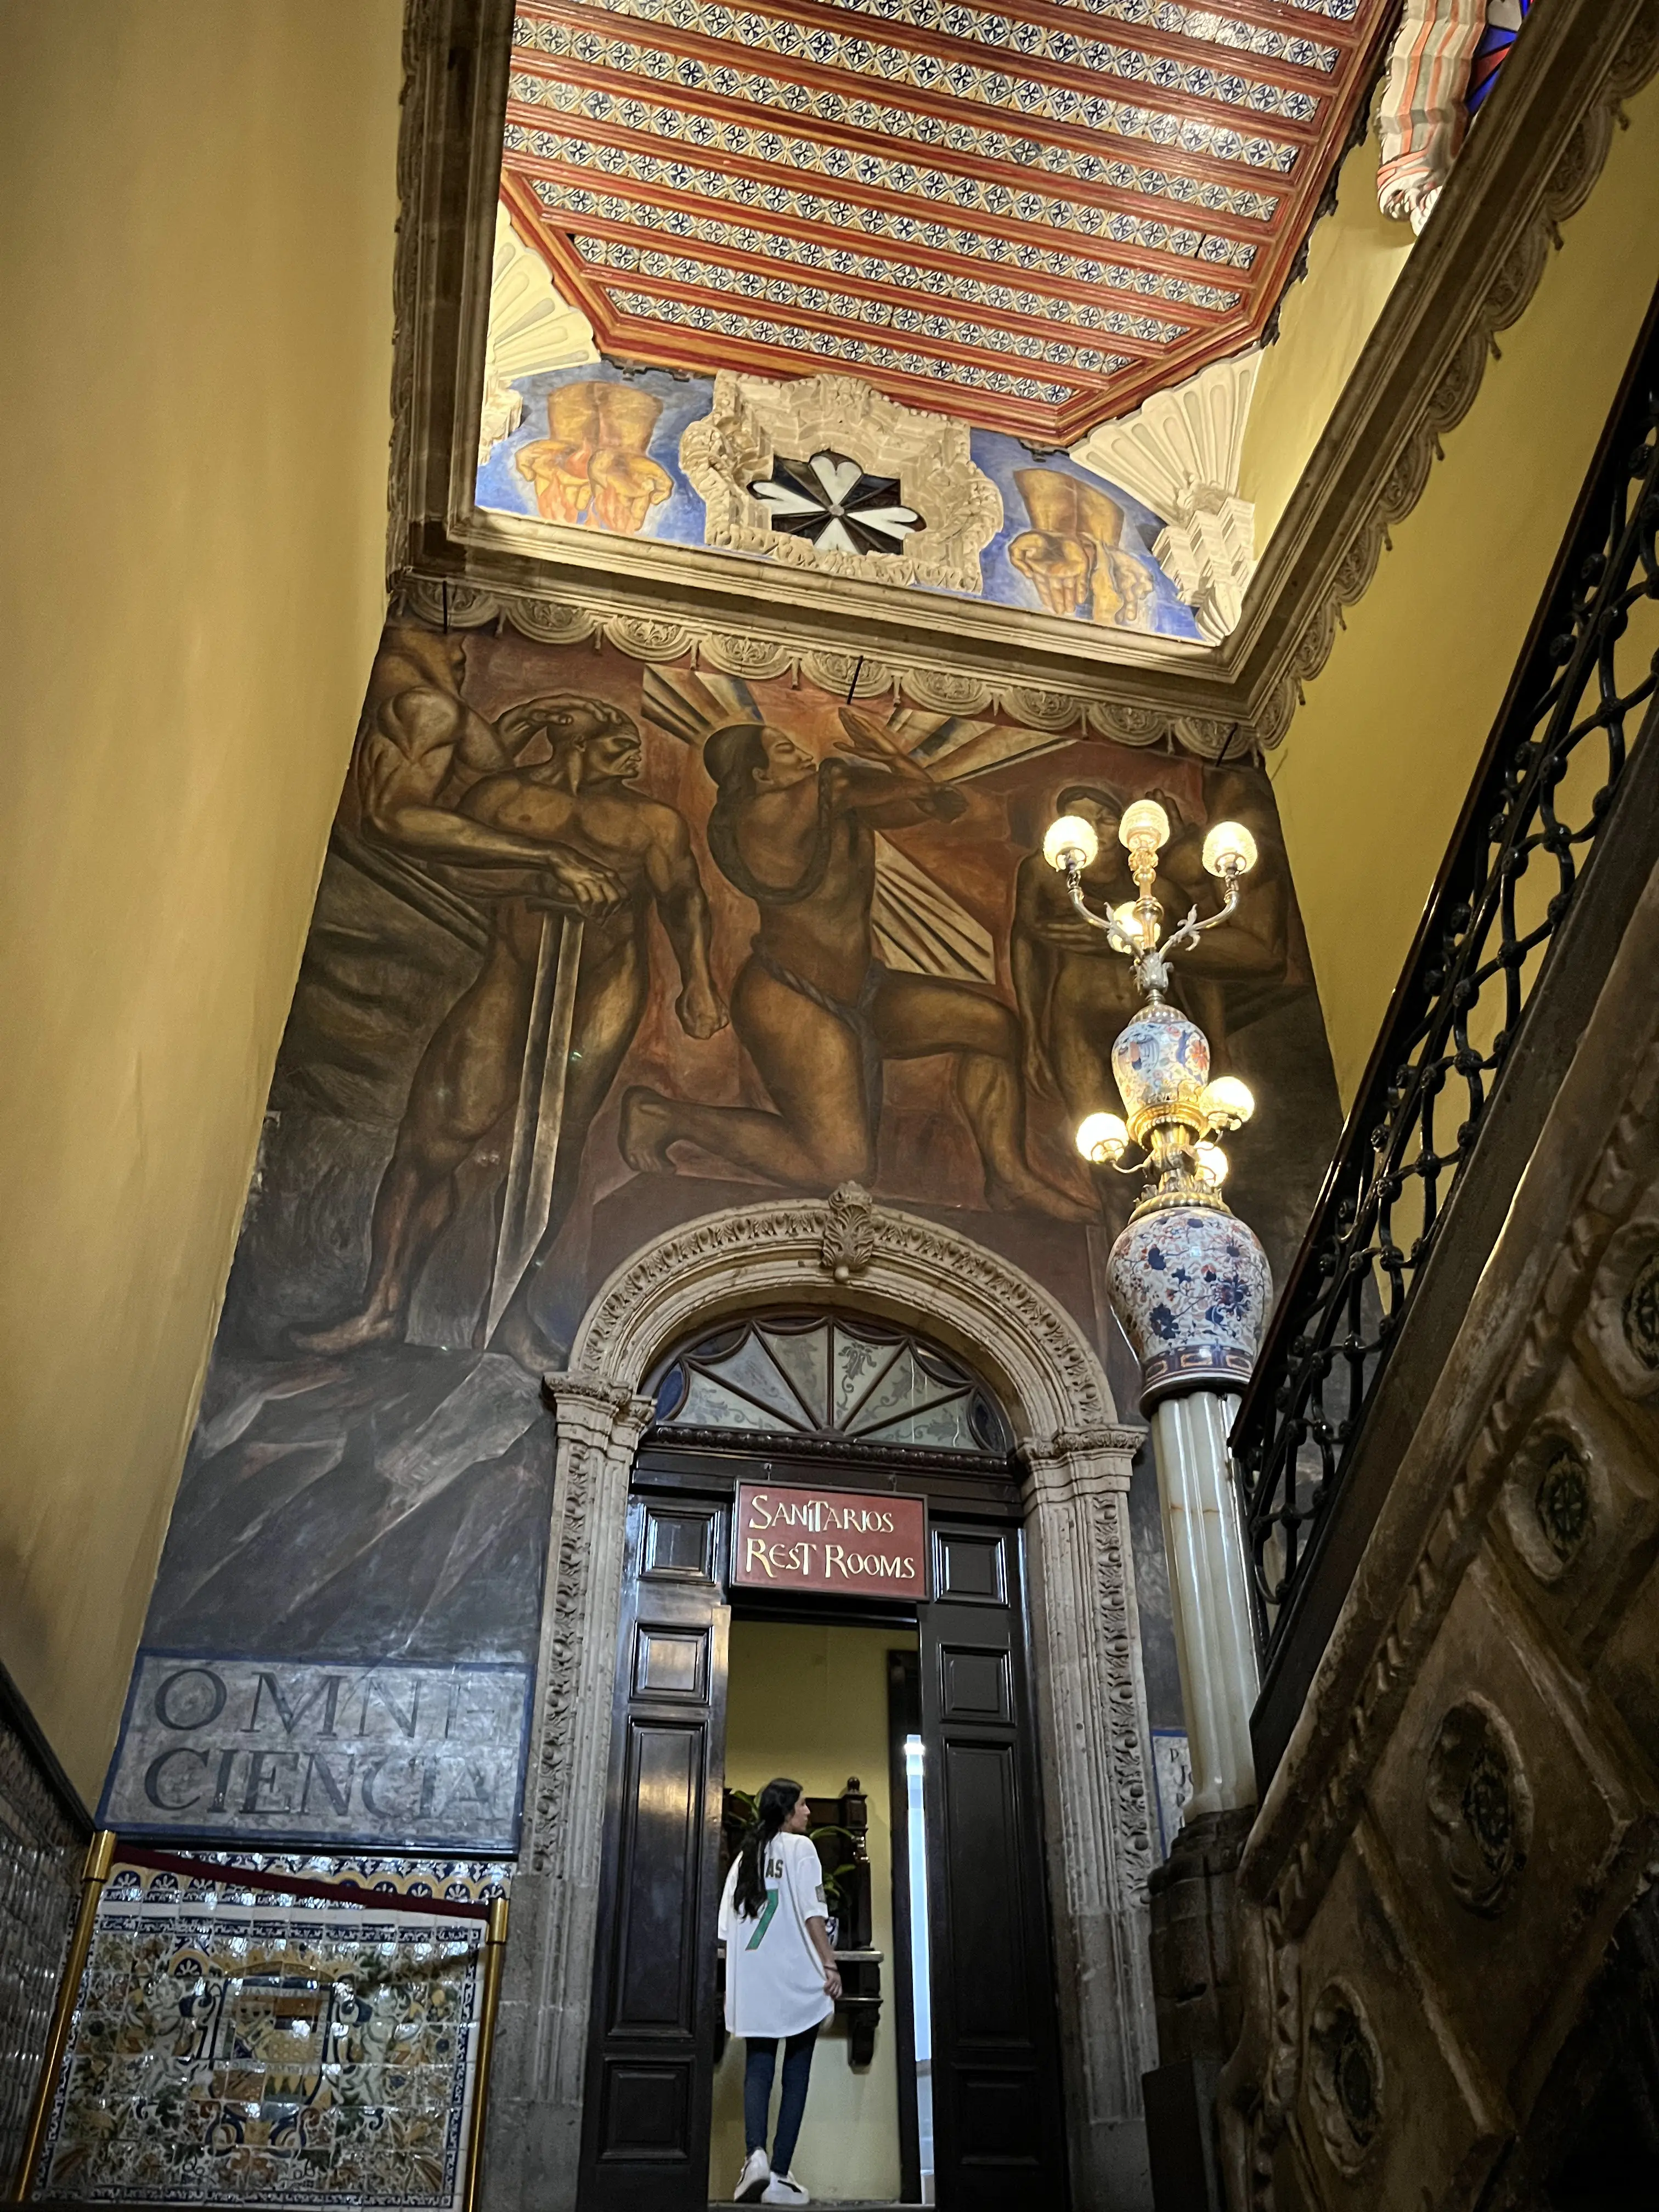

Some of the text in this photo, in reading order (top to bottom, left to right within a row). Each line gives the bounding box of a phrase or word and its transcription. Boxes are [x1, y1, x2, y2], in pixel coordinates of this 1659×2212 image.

[749, 1494, 894, 1533] SANITARIOS
[746, 1537, 916, 1579] REST ROOMS
[144, 1747, 507, 1820] CIENCIA
[765, 1858, 784, 1879] AS
